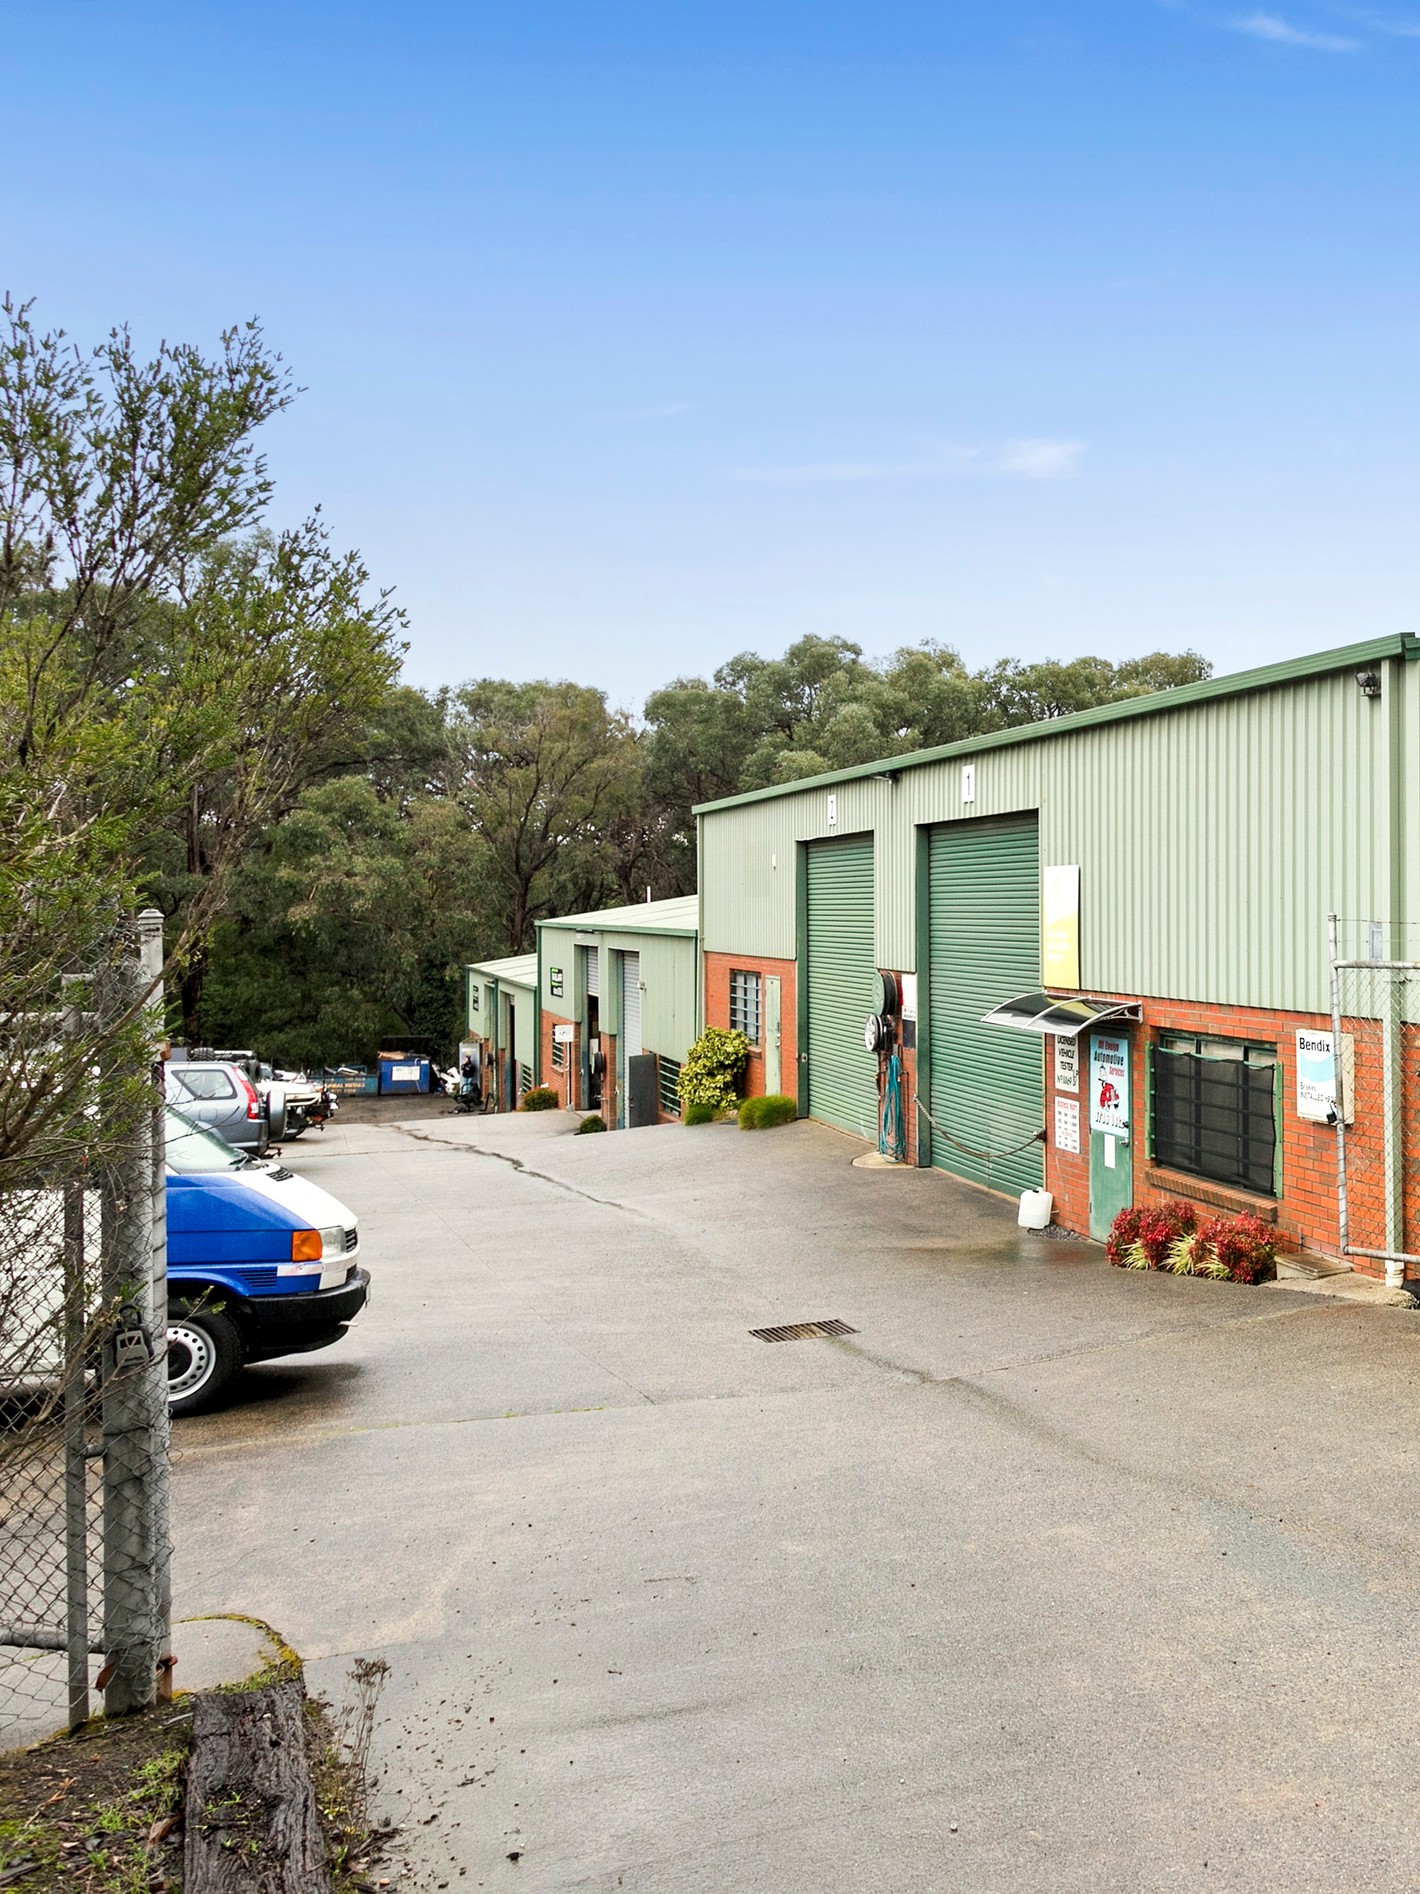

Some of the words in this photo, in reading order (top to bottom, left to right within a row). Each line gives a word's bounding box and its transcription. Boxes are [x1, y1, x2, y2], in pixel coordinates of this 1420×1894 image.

[1299, 1037, 1331, 1052] Bendix
[1058, 1048, 1075, 1059] VEHICLE
[1094, 1051, 1124, 1066] Automotive
[1060, 1061, 1073, 1071] TESTER
